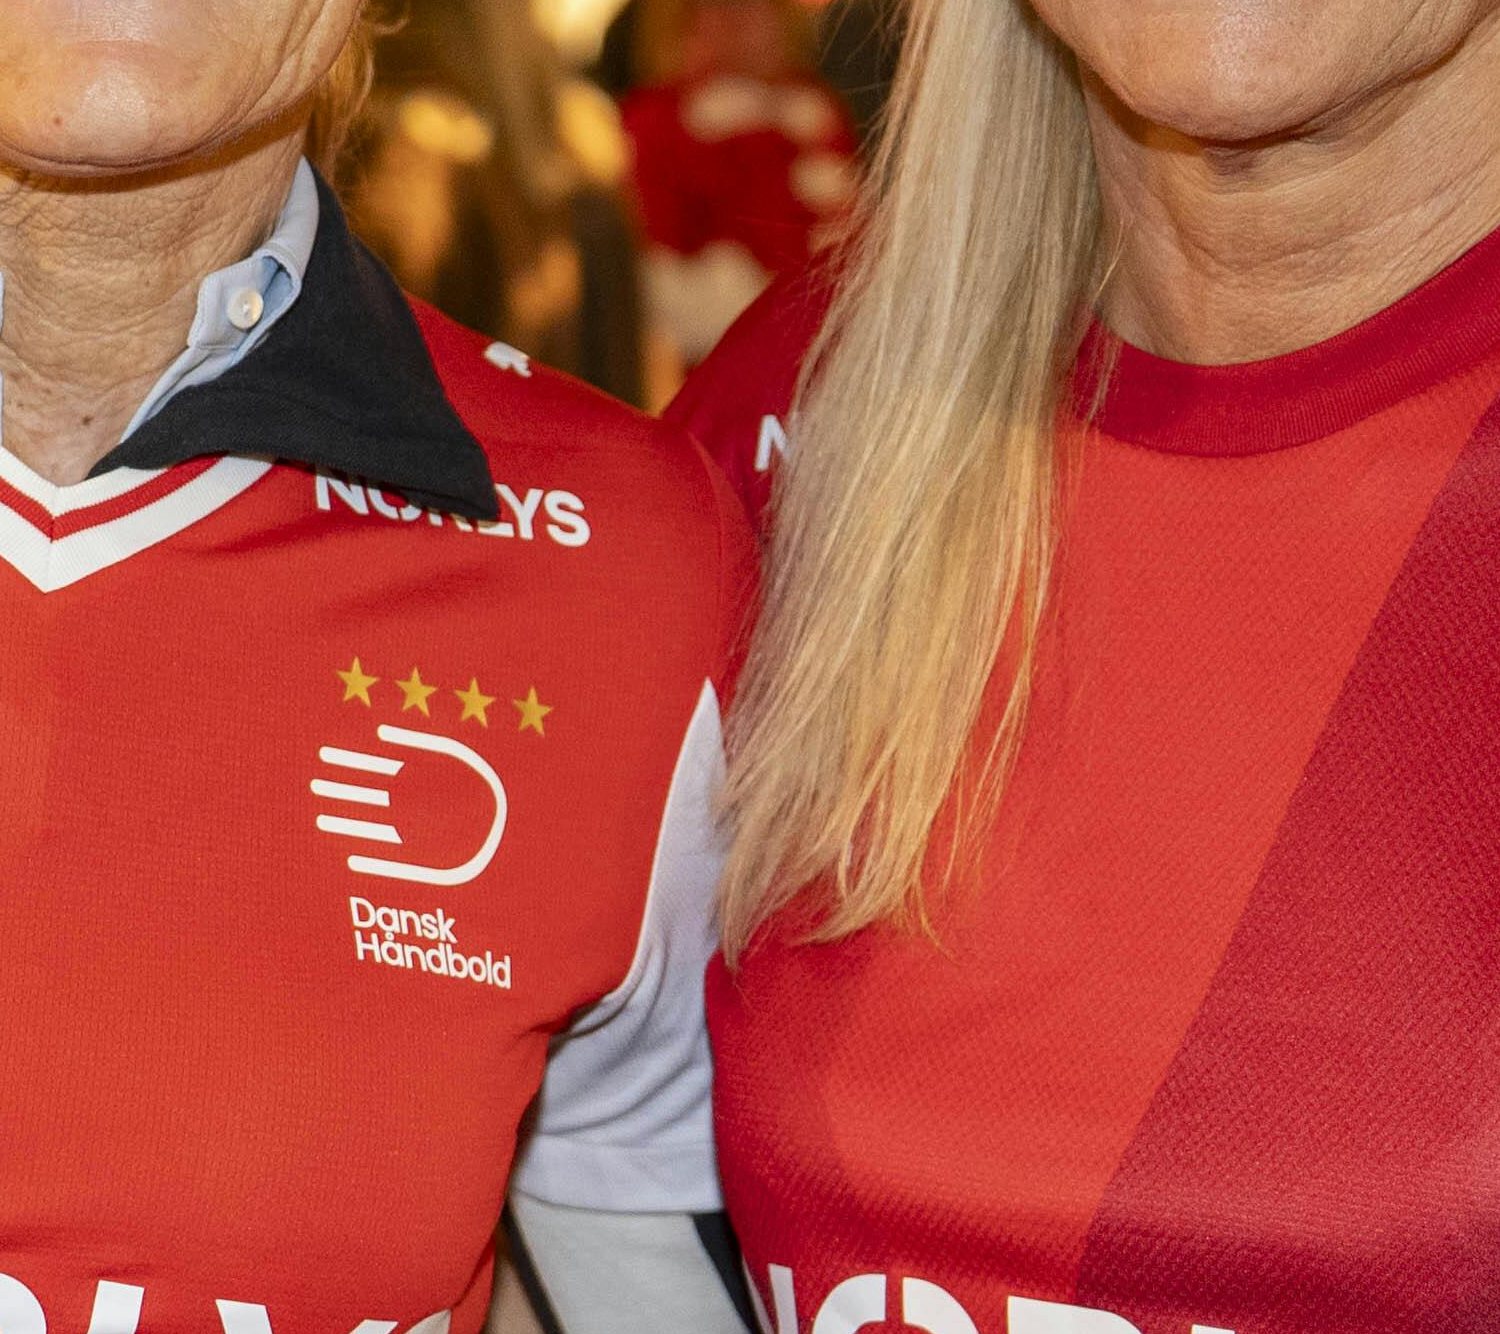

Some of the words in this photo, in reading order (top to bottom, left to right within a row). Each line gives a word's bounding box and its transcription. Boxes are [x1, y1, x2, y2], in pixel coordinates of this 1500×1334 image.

[315, 474, 591, 547] NOYS
[350, 896, 458, 943] Dansk
[354, 930, 512, 989] Håndbold
